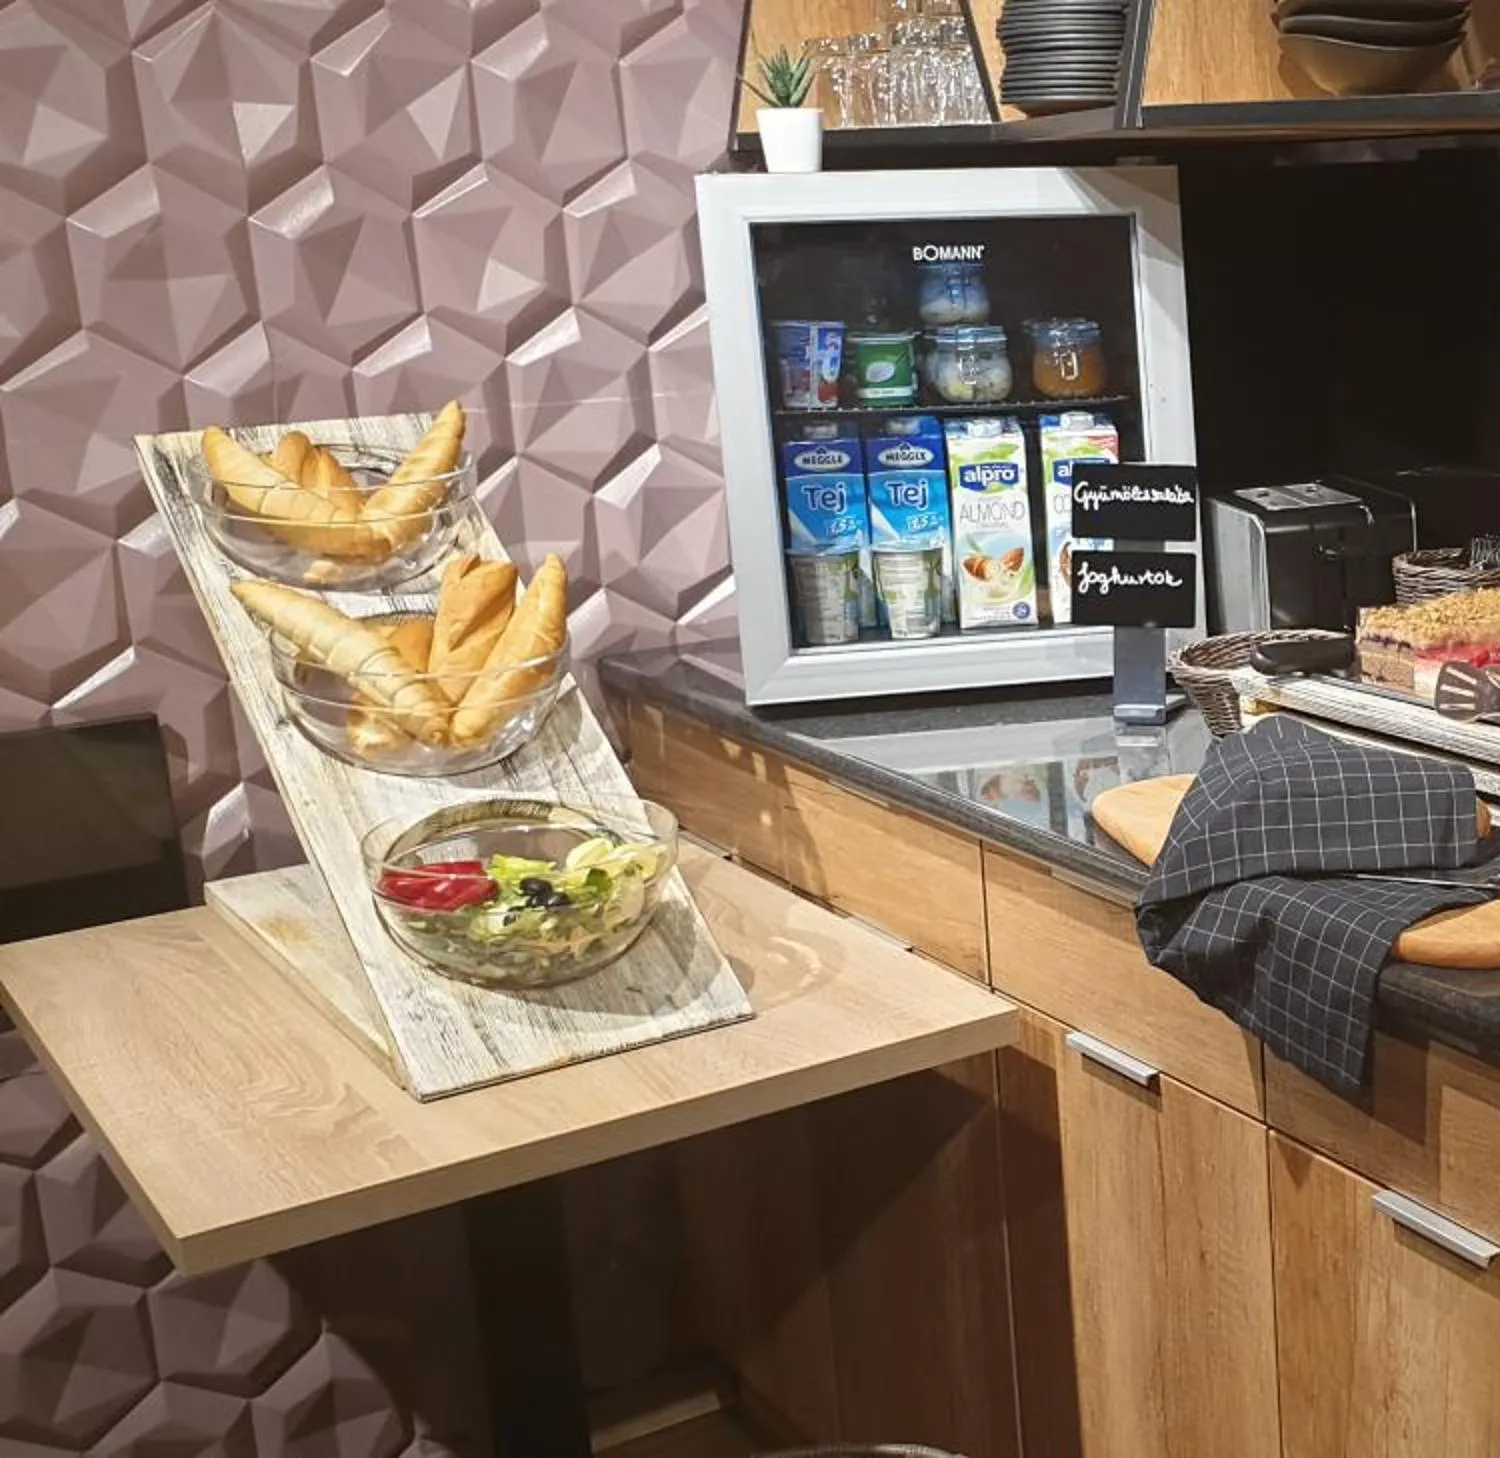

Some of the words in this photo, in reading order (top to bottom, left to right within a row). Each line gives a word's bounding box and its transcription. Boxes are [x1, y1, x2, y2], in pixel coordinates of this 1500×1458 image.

[912, 245, 984, 261] BOMANN
[963, 464, 1015, 486] alpro
[802, 482, 847, 513] Tej
[886, 479, 929, 510] Tej
[959, 500, 1026, 524] ALMOND
